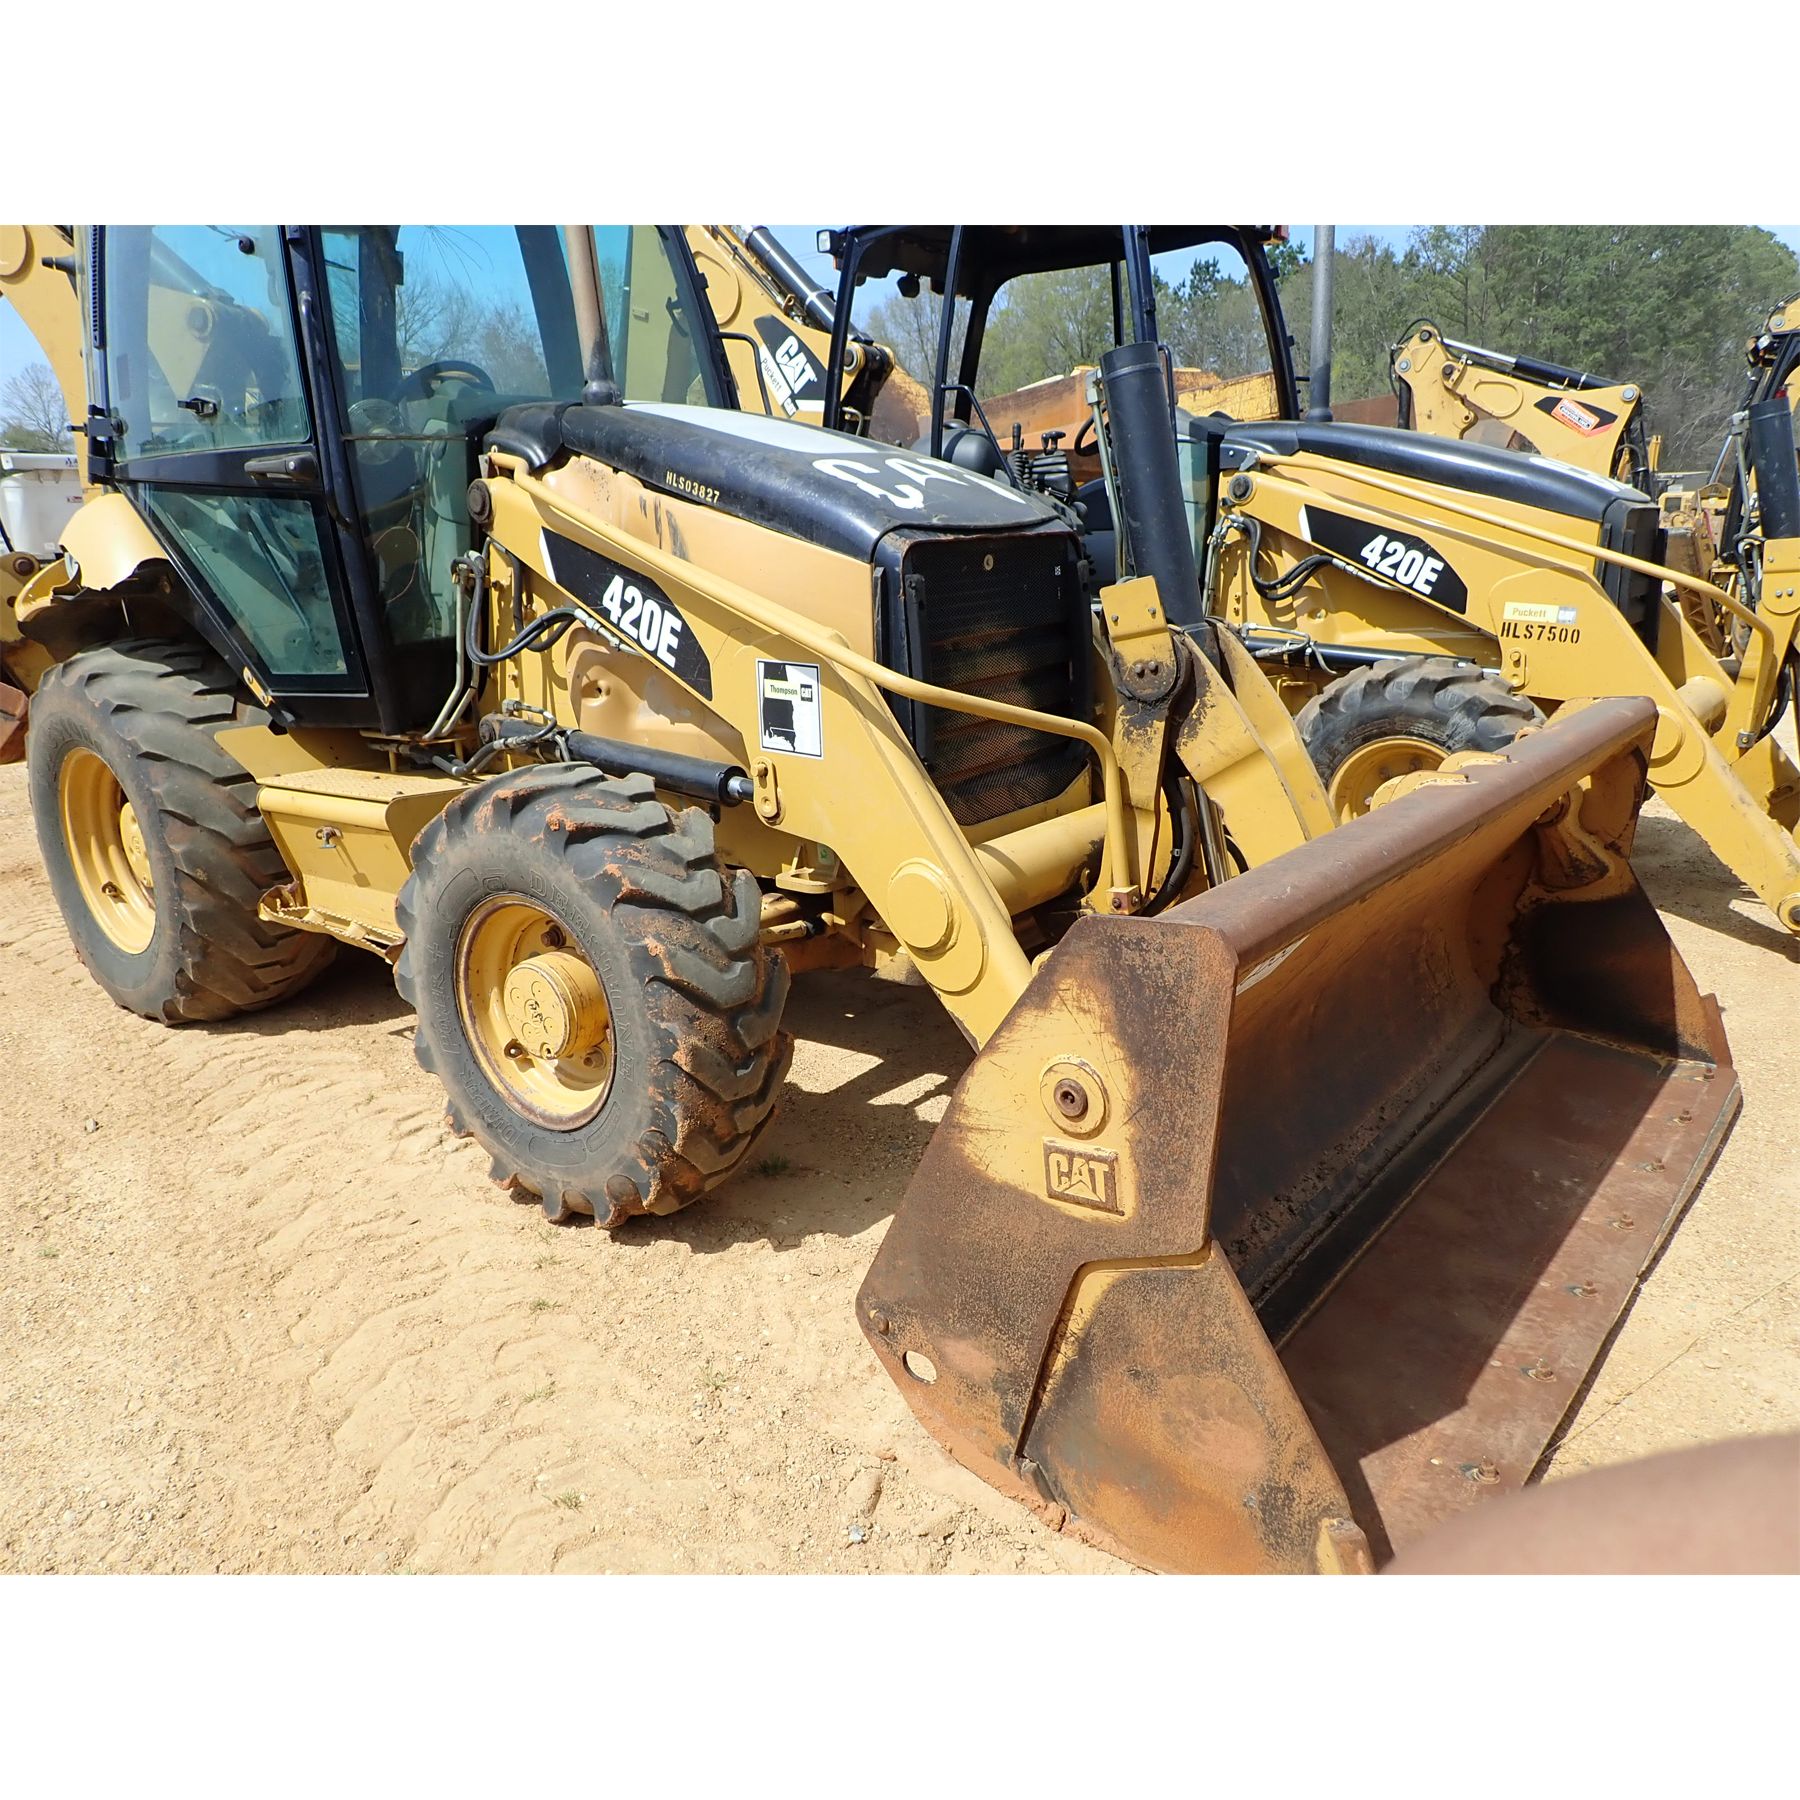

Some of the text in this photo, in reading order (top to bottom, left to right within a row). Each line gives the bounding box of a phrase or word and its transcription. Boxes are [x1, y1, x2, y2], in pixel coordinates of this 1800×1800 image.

[761, 358, 782, 392] Puckett
[775, 335, 817, 394] CAT
[666, 470, 720, 504] HLS03827
[1360, 534, 1445, 595] 420E
[602, 574, 682, 669] 420E
[1512, 607, 1547, 618] Puckett
[1500, 621, 1580, 644] HLS7500
[770, 684, 798, 696] Thompson
[1047, 1151, 1110, 1203] CAT
